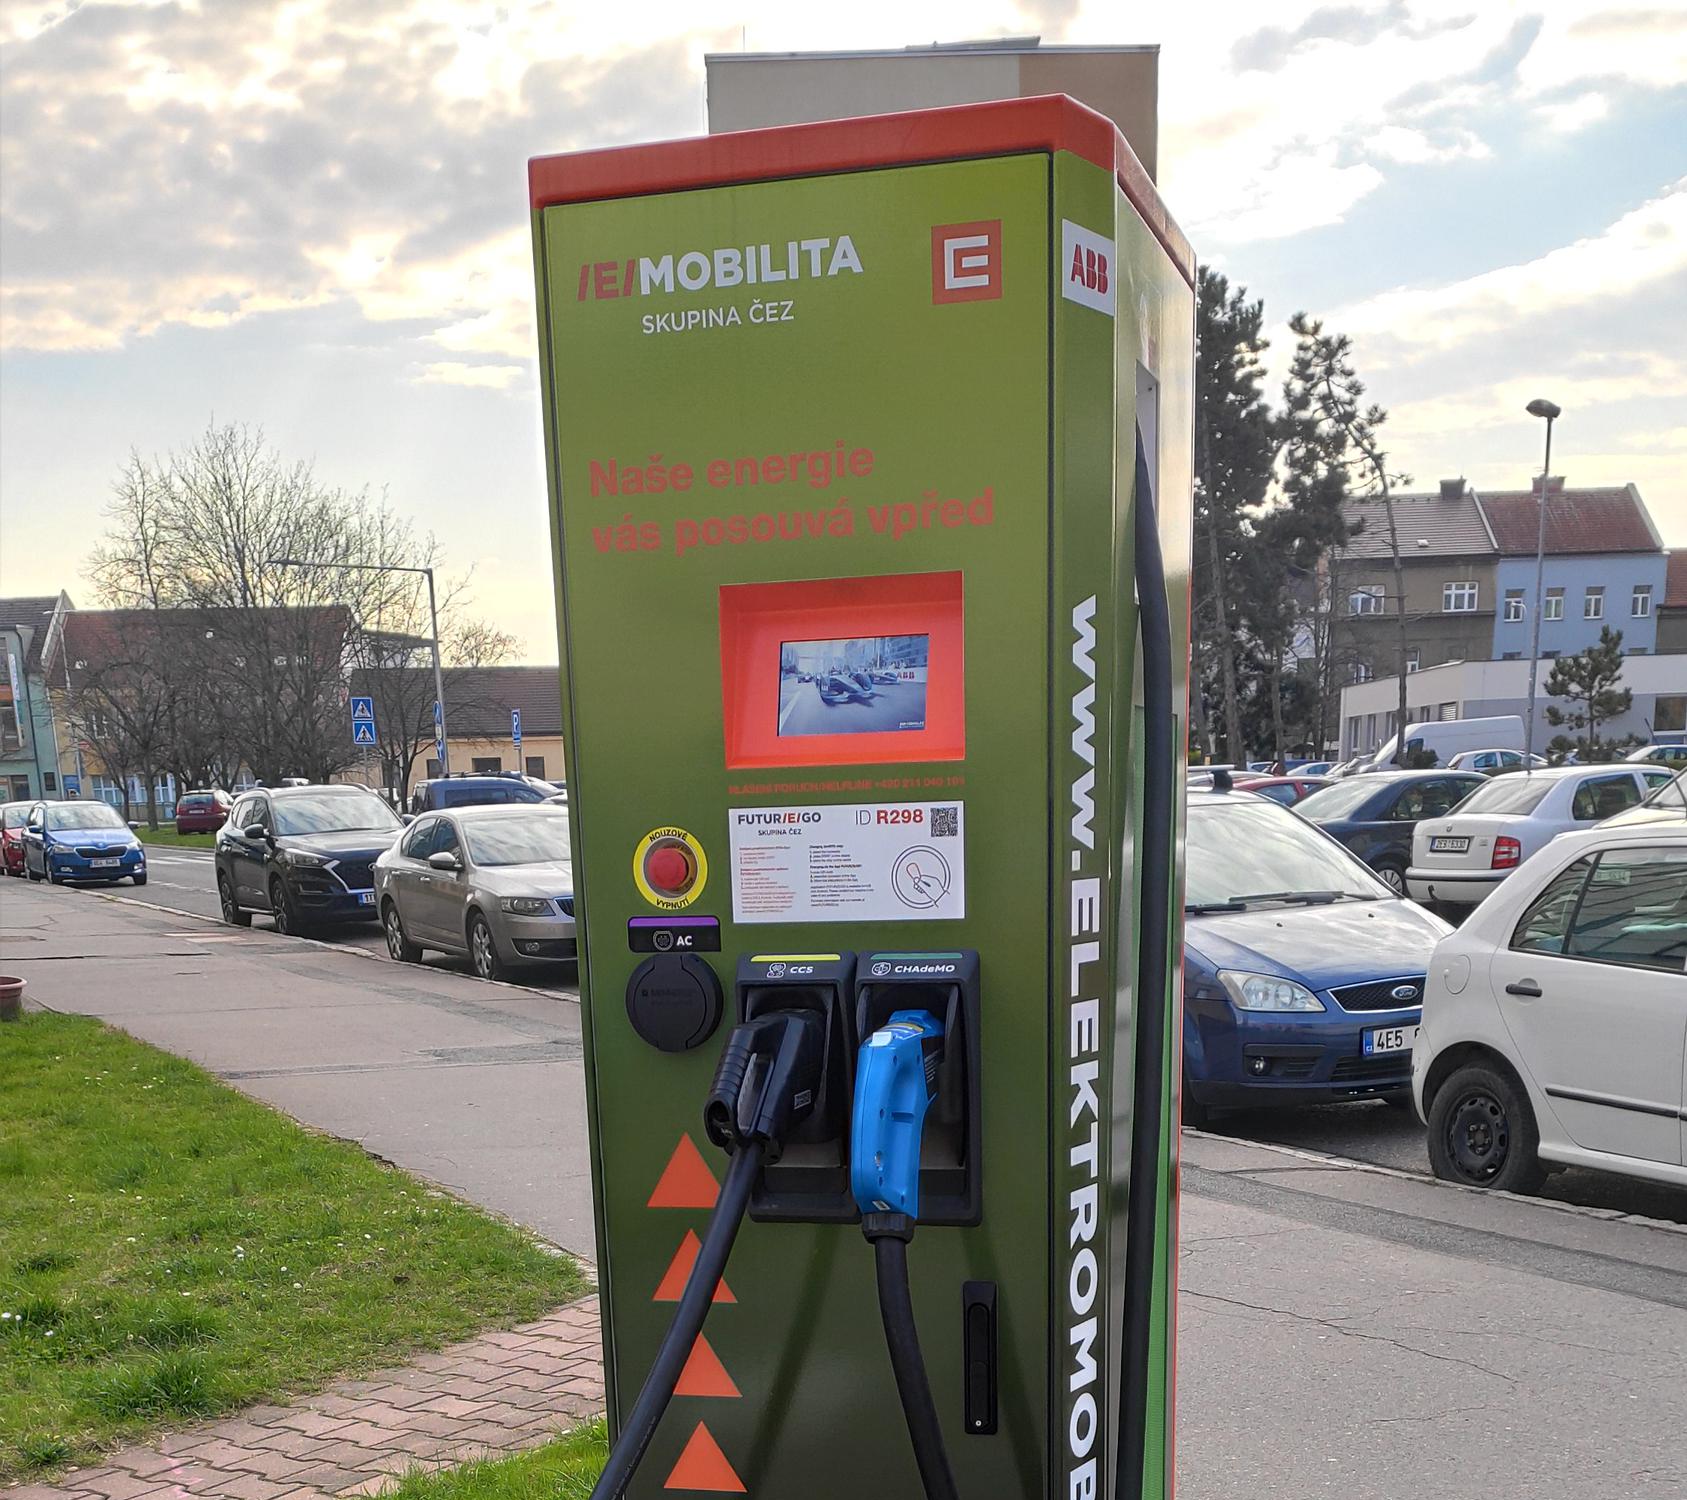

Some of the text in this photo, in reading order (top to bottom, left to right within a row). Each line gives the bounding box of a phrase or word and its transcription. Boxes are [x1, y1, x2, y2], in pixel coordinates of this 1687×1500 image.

[1070, 243, 1109, 295] ABB
[642, 299, 795, 334] SKUPINA ČEZ
[589, 439, 875, 497] Naše energie
[592, 486, 995, 557] vás posouvá vpřed
[855, 811, 871, 826] ID
[876, 809, 924, 825] R298
[648, 828, 689, 843] NOUZOVÉ
[757, 826, 803, 837] SKUPINA ČEZ
[656, 896, 690, 910] VYPNUTÍ
[676, 935, 693, 947] AC
[789, 965, 814, 975] CCS
[894, 963, 956, 974] CHAdeMO
[1377, 1029, 1404, 1051] 4E5
